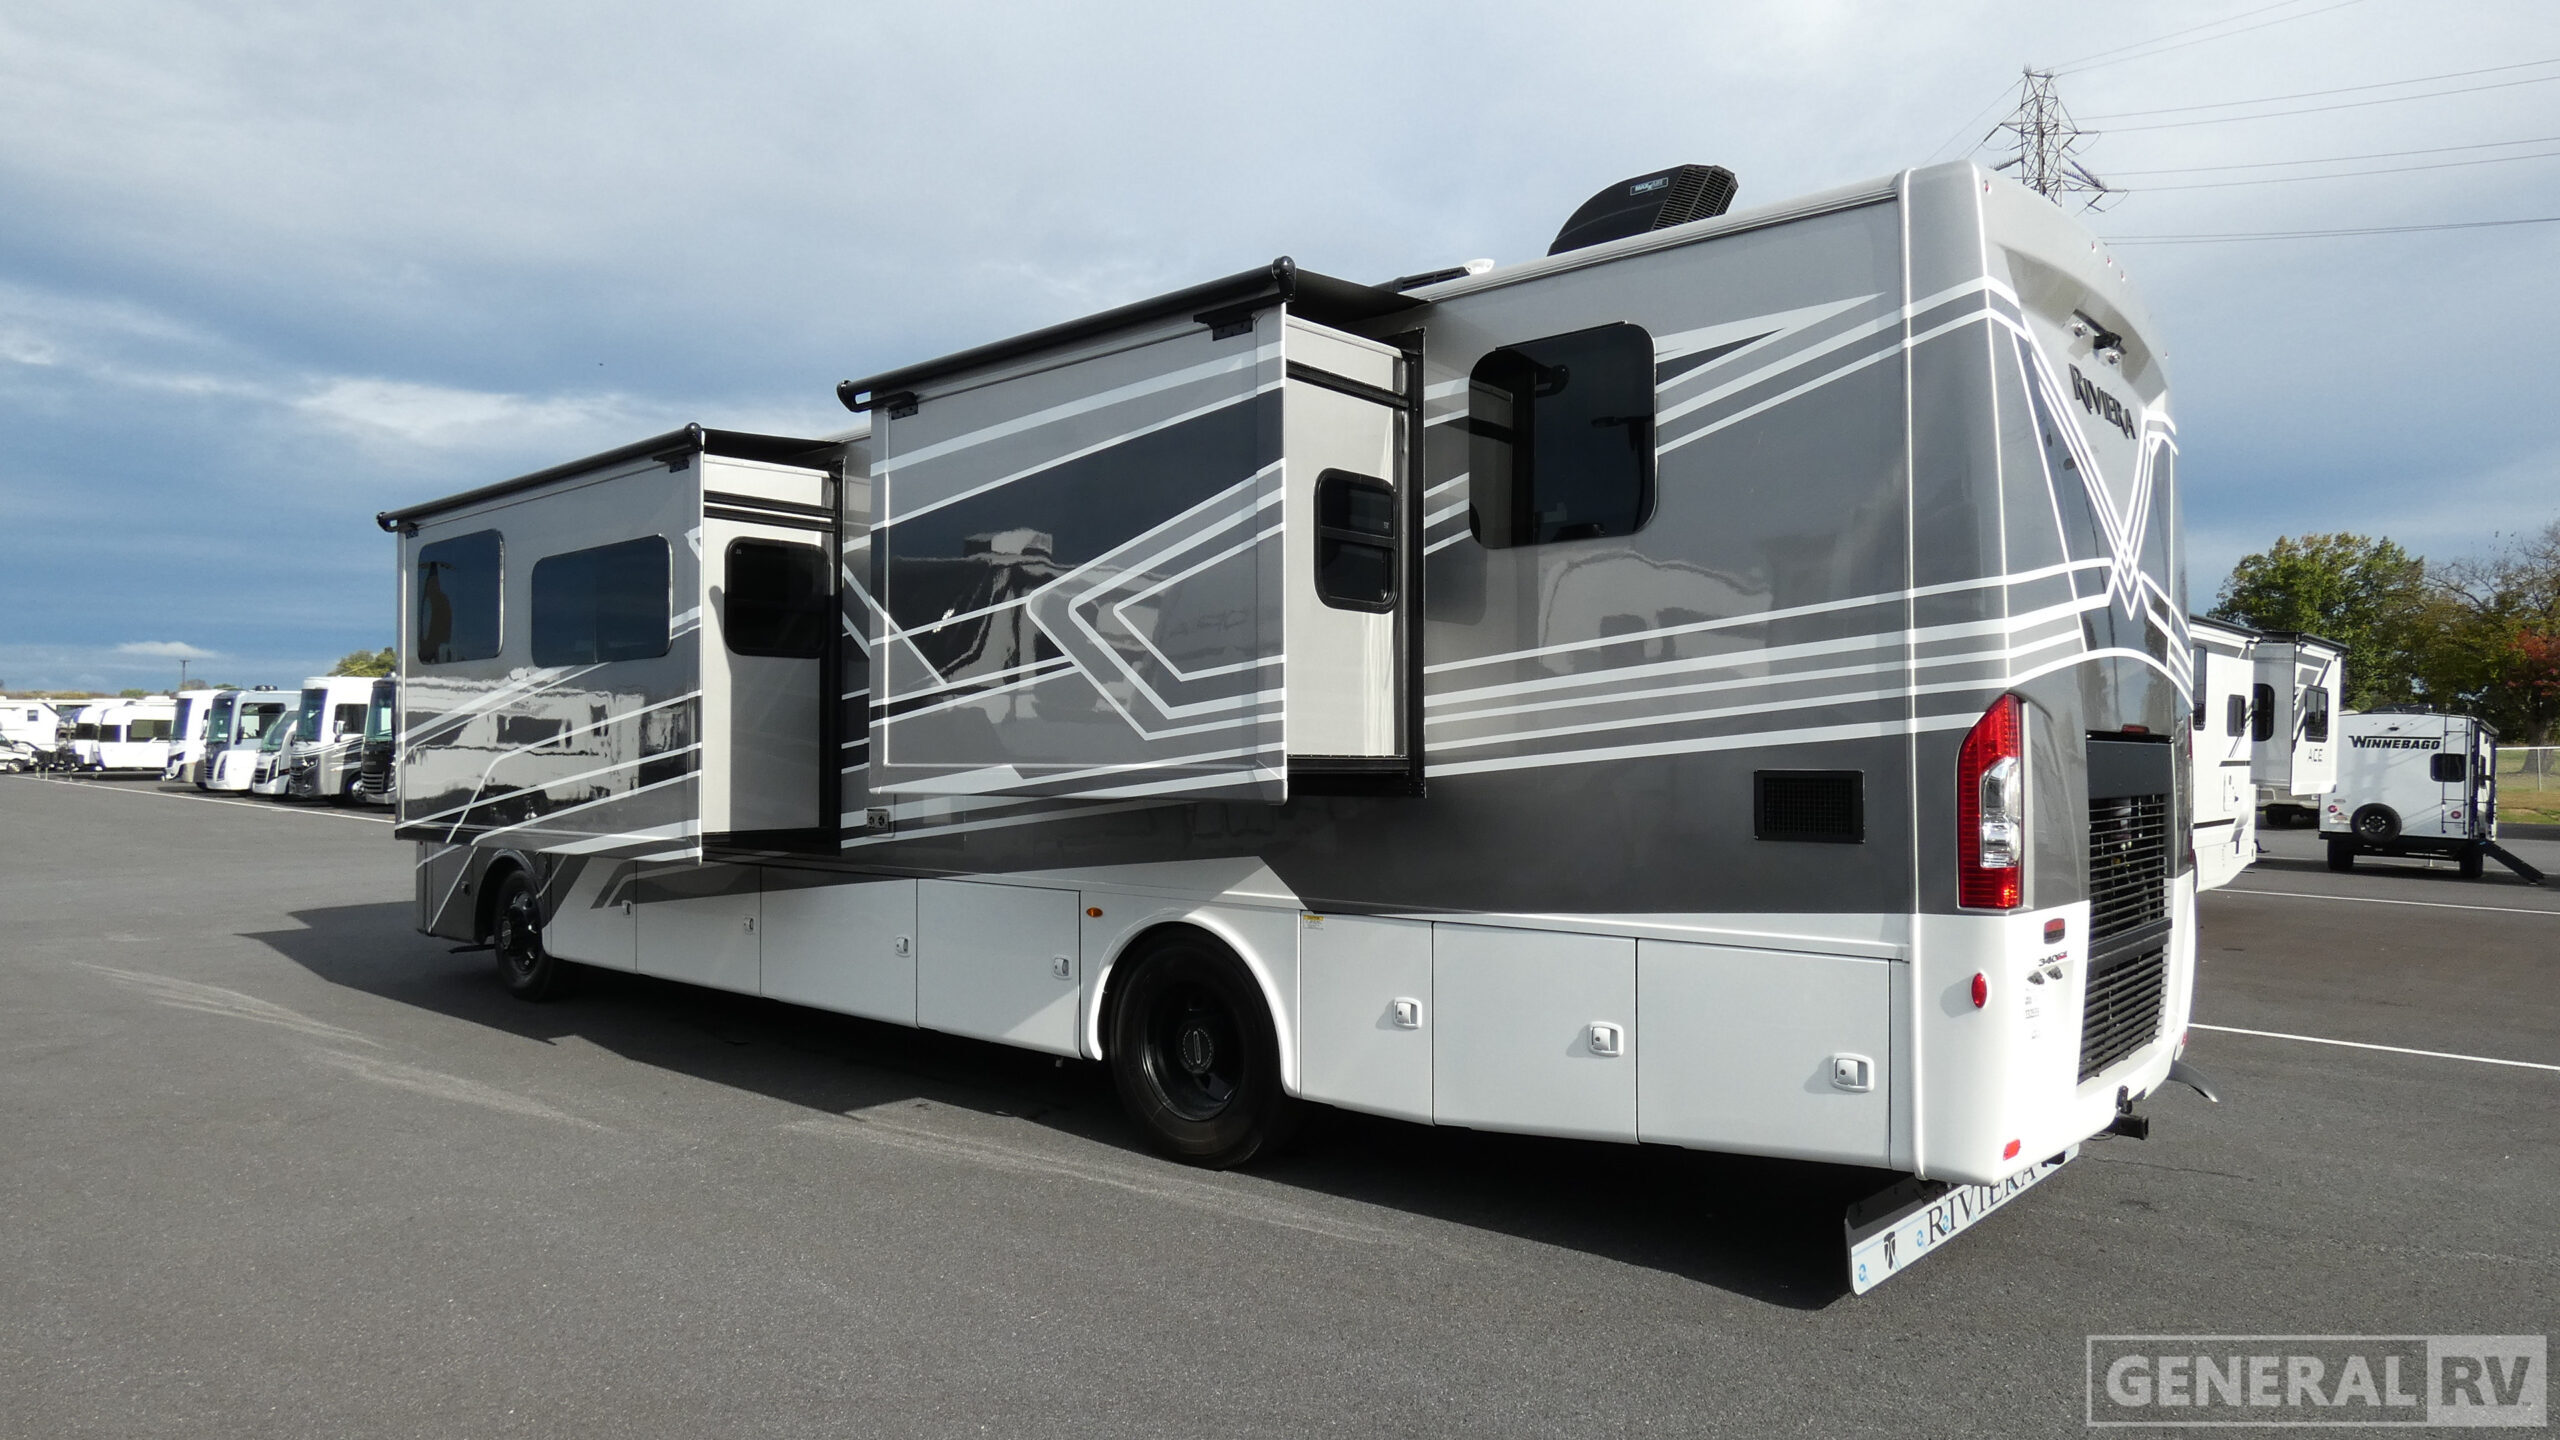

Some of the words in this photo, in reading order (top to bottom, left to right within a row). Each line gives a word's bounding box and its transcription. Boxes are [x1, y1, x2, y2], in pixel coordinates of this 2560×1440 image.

[2068, 363, 2136, 440] RIVIERA
[2348, 735, 2442, 750] WINNEBAGO
[2308, 748, 2323, 763] ACE
